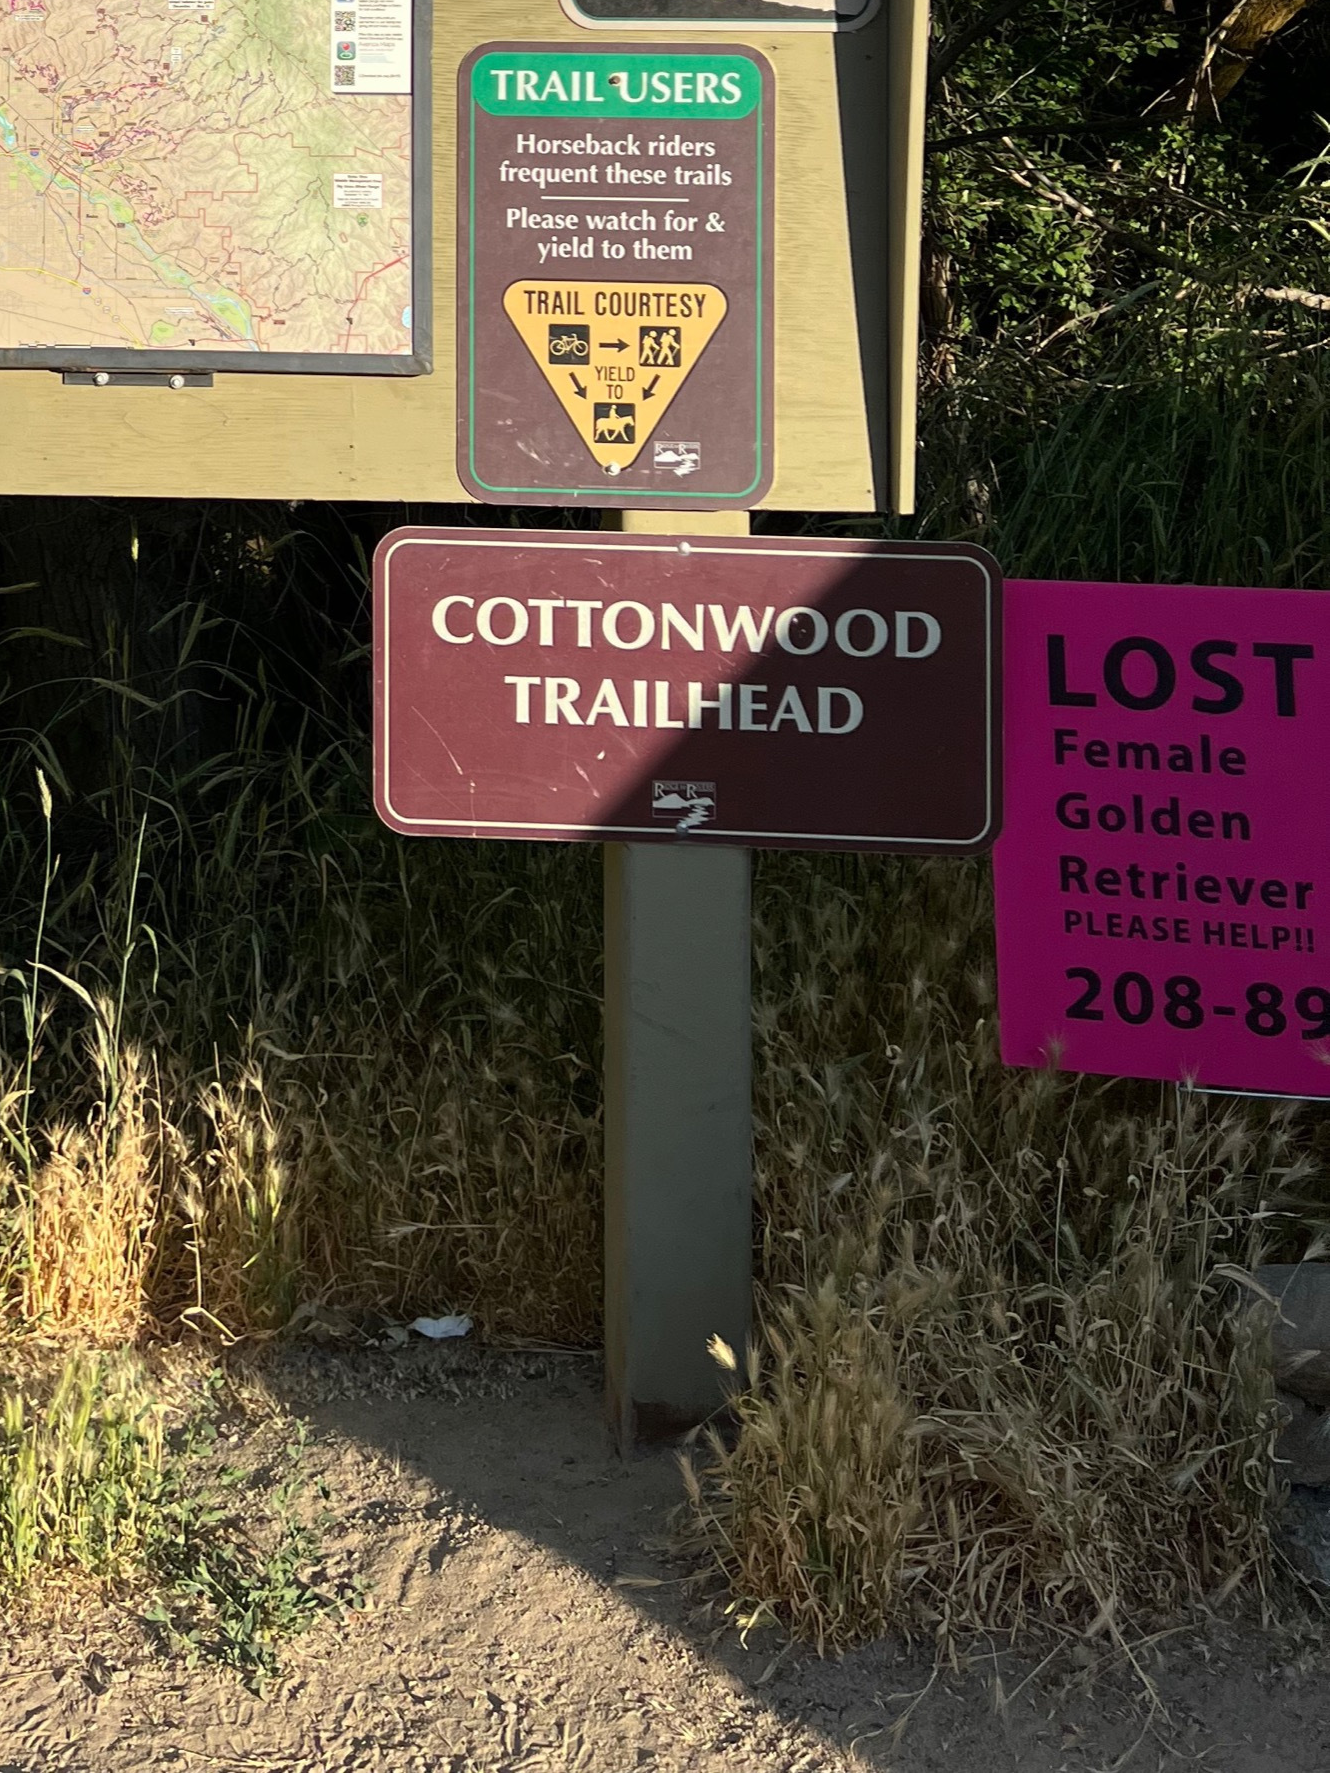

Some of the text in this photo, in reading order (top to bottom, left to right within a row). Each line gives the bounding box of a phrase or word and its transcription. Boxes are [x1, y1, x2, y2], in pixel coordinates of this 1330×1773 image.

[490, 70, 742, 104] TRAIL USERS
[516, 133, 716, 157] Horseback riders
[499, 160, 733, 189] frequent these trails
[506, 207, 726, 233] Please watch for &
[537, 236, 693, 264] yield to them
[523, 290, 707, 318] TRAIL COURTESY
[594, 365, 636, 382] YIELD
[605, 384, 624, 400] TO
[431, 595, 943, 659] COTTONWOOD
[1046, 634, 1314, 717] LOST
[504, 675, 864, 735] TRAILHEAD
[1054, 728, 1247, 776] Female
[1055, 791, 1251, 841] Golden
[1059, 854, 1315, 911] Retriever
[1064, 909, 1316, 954] PLEASE HELP!!
[1064, 966, 1330, 1041] 208-89
